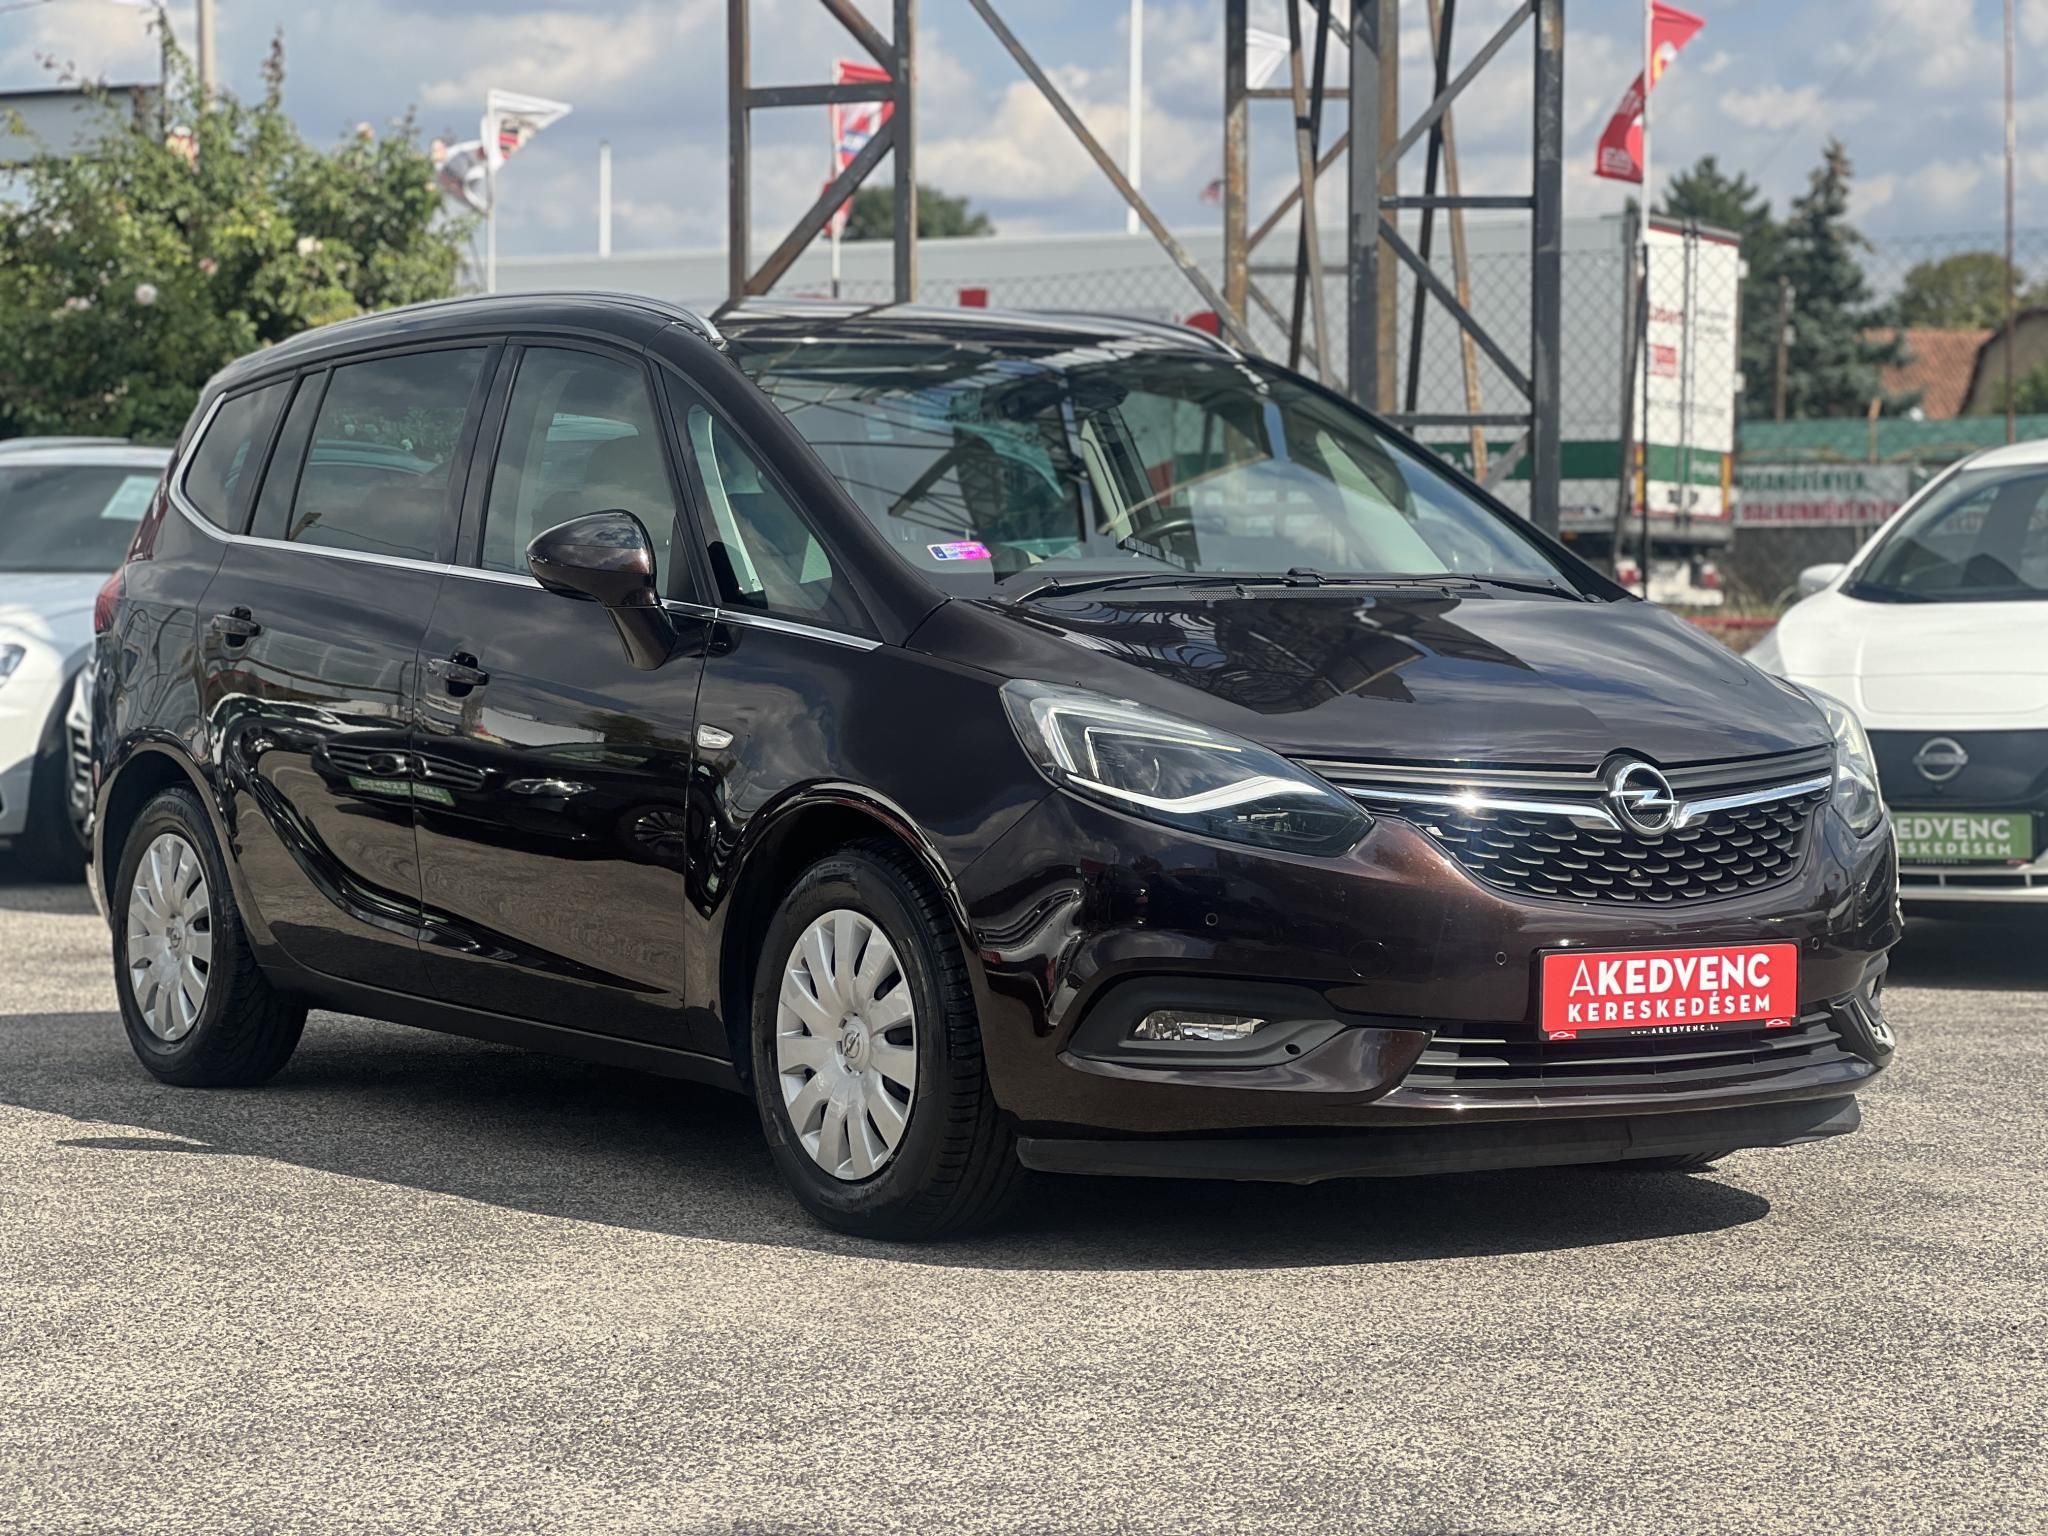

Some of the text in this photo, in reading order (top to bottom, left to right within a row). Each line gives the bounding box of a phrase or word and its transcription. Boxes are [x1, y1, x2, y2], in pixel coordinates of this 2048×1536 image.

[1897, 817, 2010, 840] EDVENC
[1898, 838, 2011, 855] ESKEDÉSEM
[1568, 991, 1770, 1022] KERESKEDÉSEM
